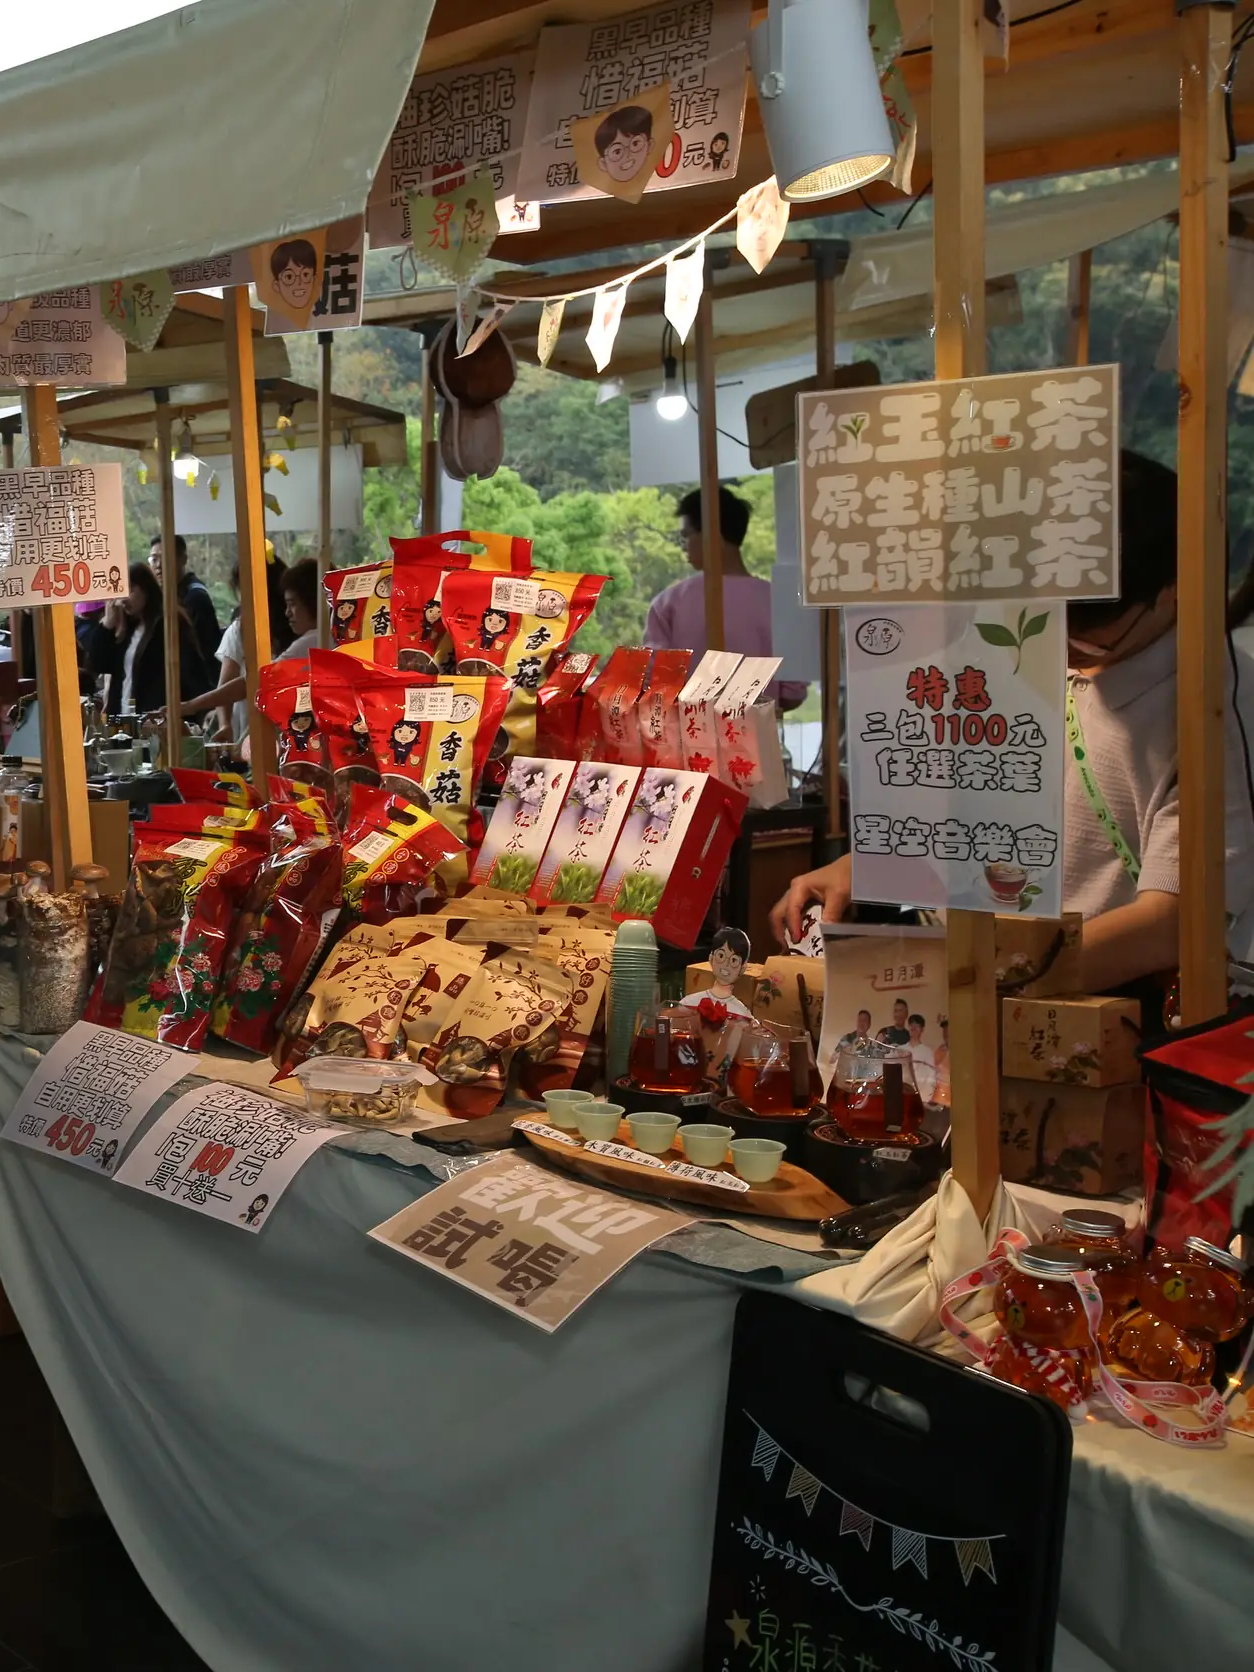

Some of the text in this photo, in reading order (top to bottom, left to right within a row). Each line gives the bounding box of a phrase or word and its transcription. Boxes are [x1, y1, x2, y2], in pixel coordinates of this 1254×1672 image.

[585, 2, 713, 62] 黑早品種
[683, 142, 706, 167] 元
[806, 376, 1109, 468] 紅玉紅茶
[810, 458, 1112, 530] 原生種山茶
[31, 561, 91, 598] 450
[92, 570, 108, 588] 元
[808, 516, 1109, 595] 紅韻紅茶
[511, 626, 552, 689] 香菇
[907, 665, 992, 711] 特惠
[860, 709, 1047, 748] 三包1100元
[429, 731, 464, 804] 香菇
[876, 747, 1041, 793] 任選茶葉
[854, 814, 1058, 867] 星空音樂會
[61, 1052, 150, 1101] 惜福菇
[83, 1031, 173, 1073] 黑早品種
[34, 1081, 133, 1131] 自用更划算
[19, 1114, 106, 1157] 特價 450 元
[177, 1107, 298, 1160] 酥脆涮嘴!
[586, 1140, 634, 1160] 木質風味
[146, 1162, 233, 1205] 買十送一
[190, 1141, 235, 1176] 100
[229, 1155, 267, 1187] 元
[666, 1161, 718, 1183] 薄荷風味
[457, 1164, 661, 1256] 歡迎
[401, 1205, 580, 1307] 試喝
